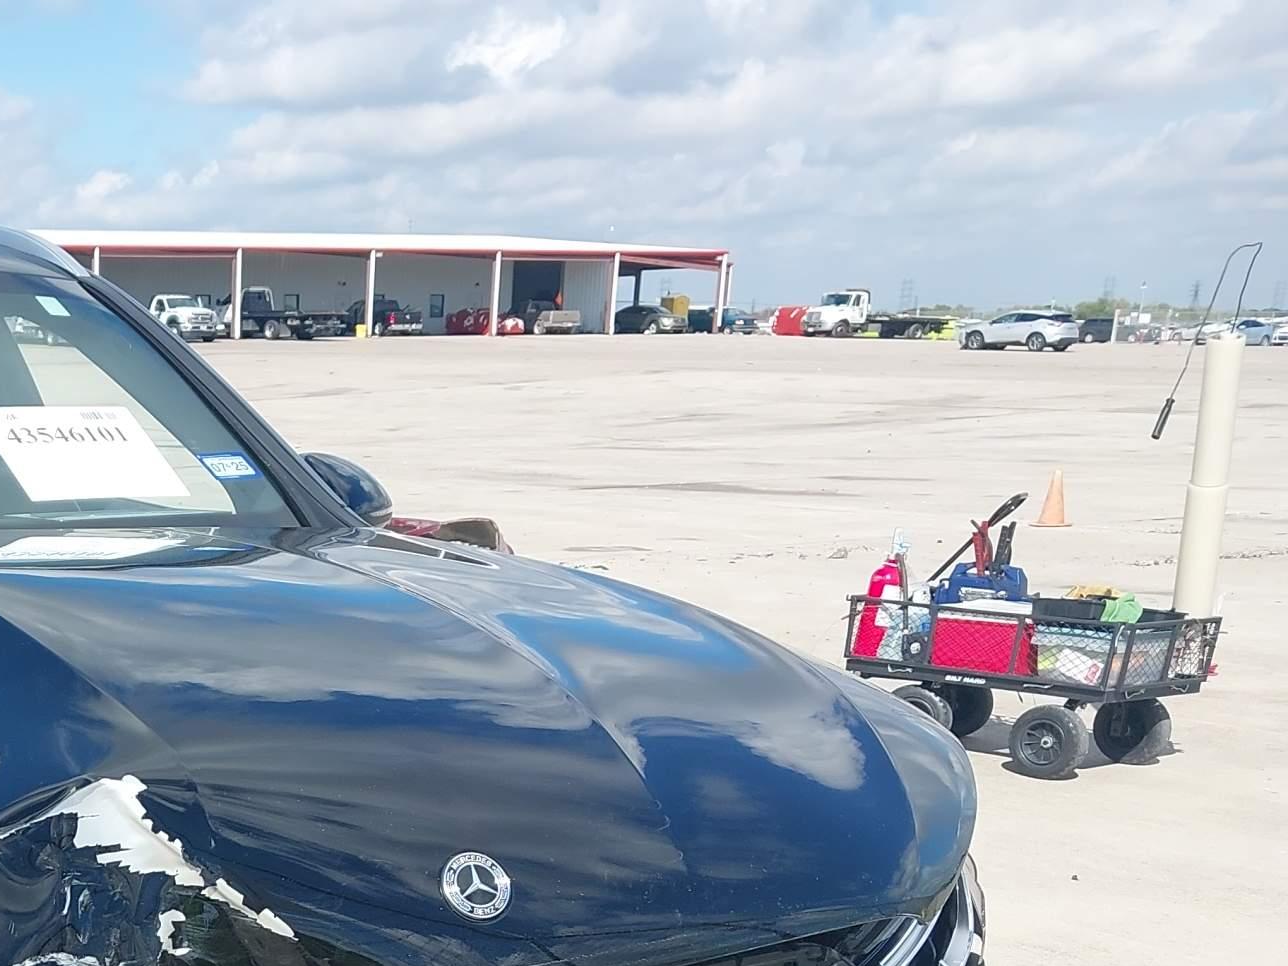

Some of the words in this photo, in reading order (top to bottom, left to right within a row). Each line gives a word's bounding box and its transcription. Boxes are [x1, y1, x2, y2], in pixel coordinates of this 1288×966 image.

[6, 426, 128, 444] 43546101
[451, 855, 492, 869] MERCEDES
[473, 907, 496, 916] BENZ
